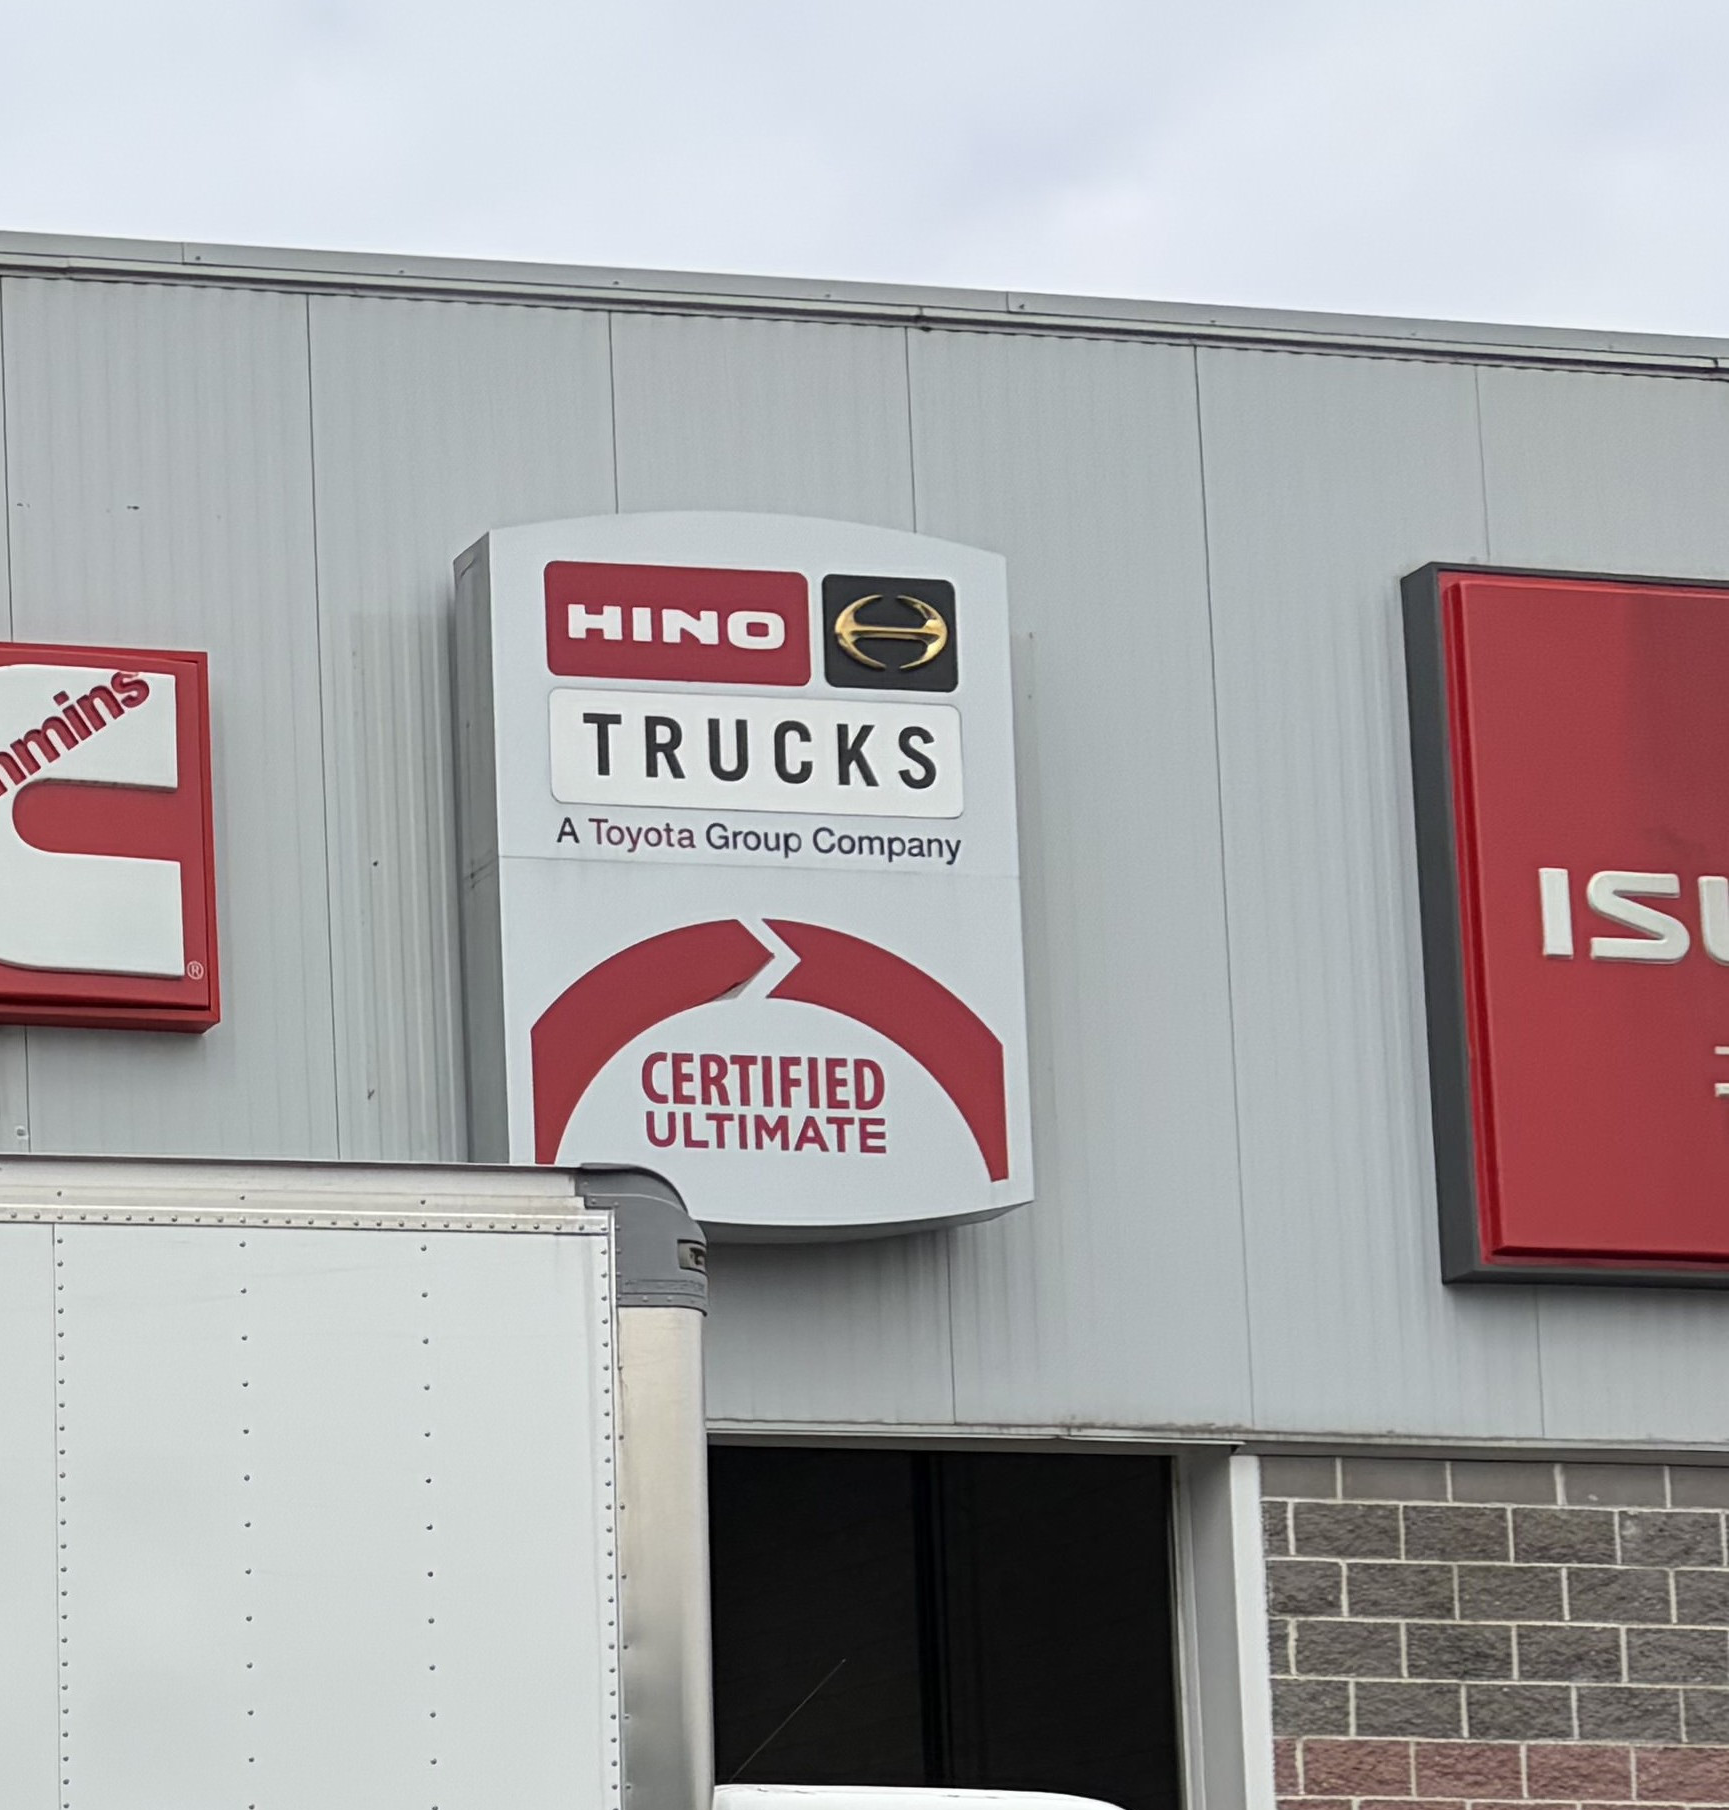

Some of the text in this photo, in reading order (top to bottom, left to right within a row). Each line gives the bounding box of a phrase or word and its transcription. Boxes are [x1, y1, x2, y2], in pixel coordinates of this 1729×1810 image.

[567, 603, 785, 650] HINO
[582, 712, 937, 790] TRUCKS
[556, 816, 962, 866] A Toyota Group Company
[641, 1052, 886, 1111] CERTIFIED
[645, 1111, 887, 1154] ULTIMATE
